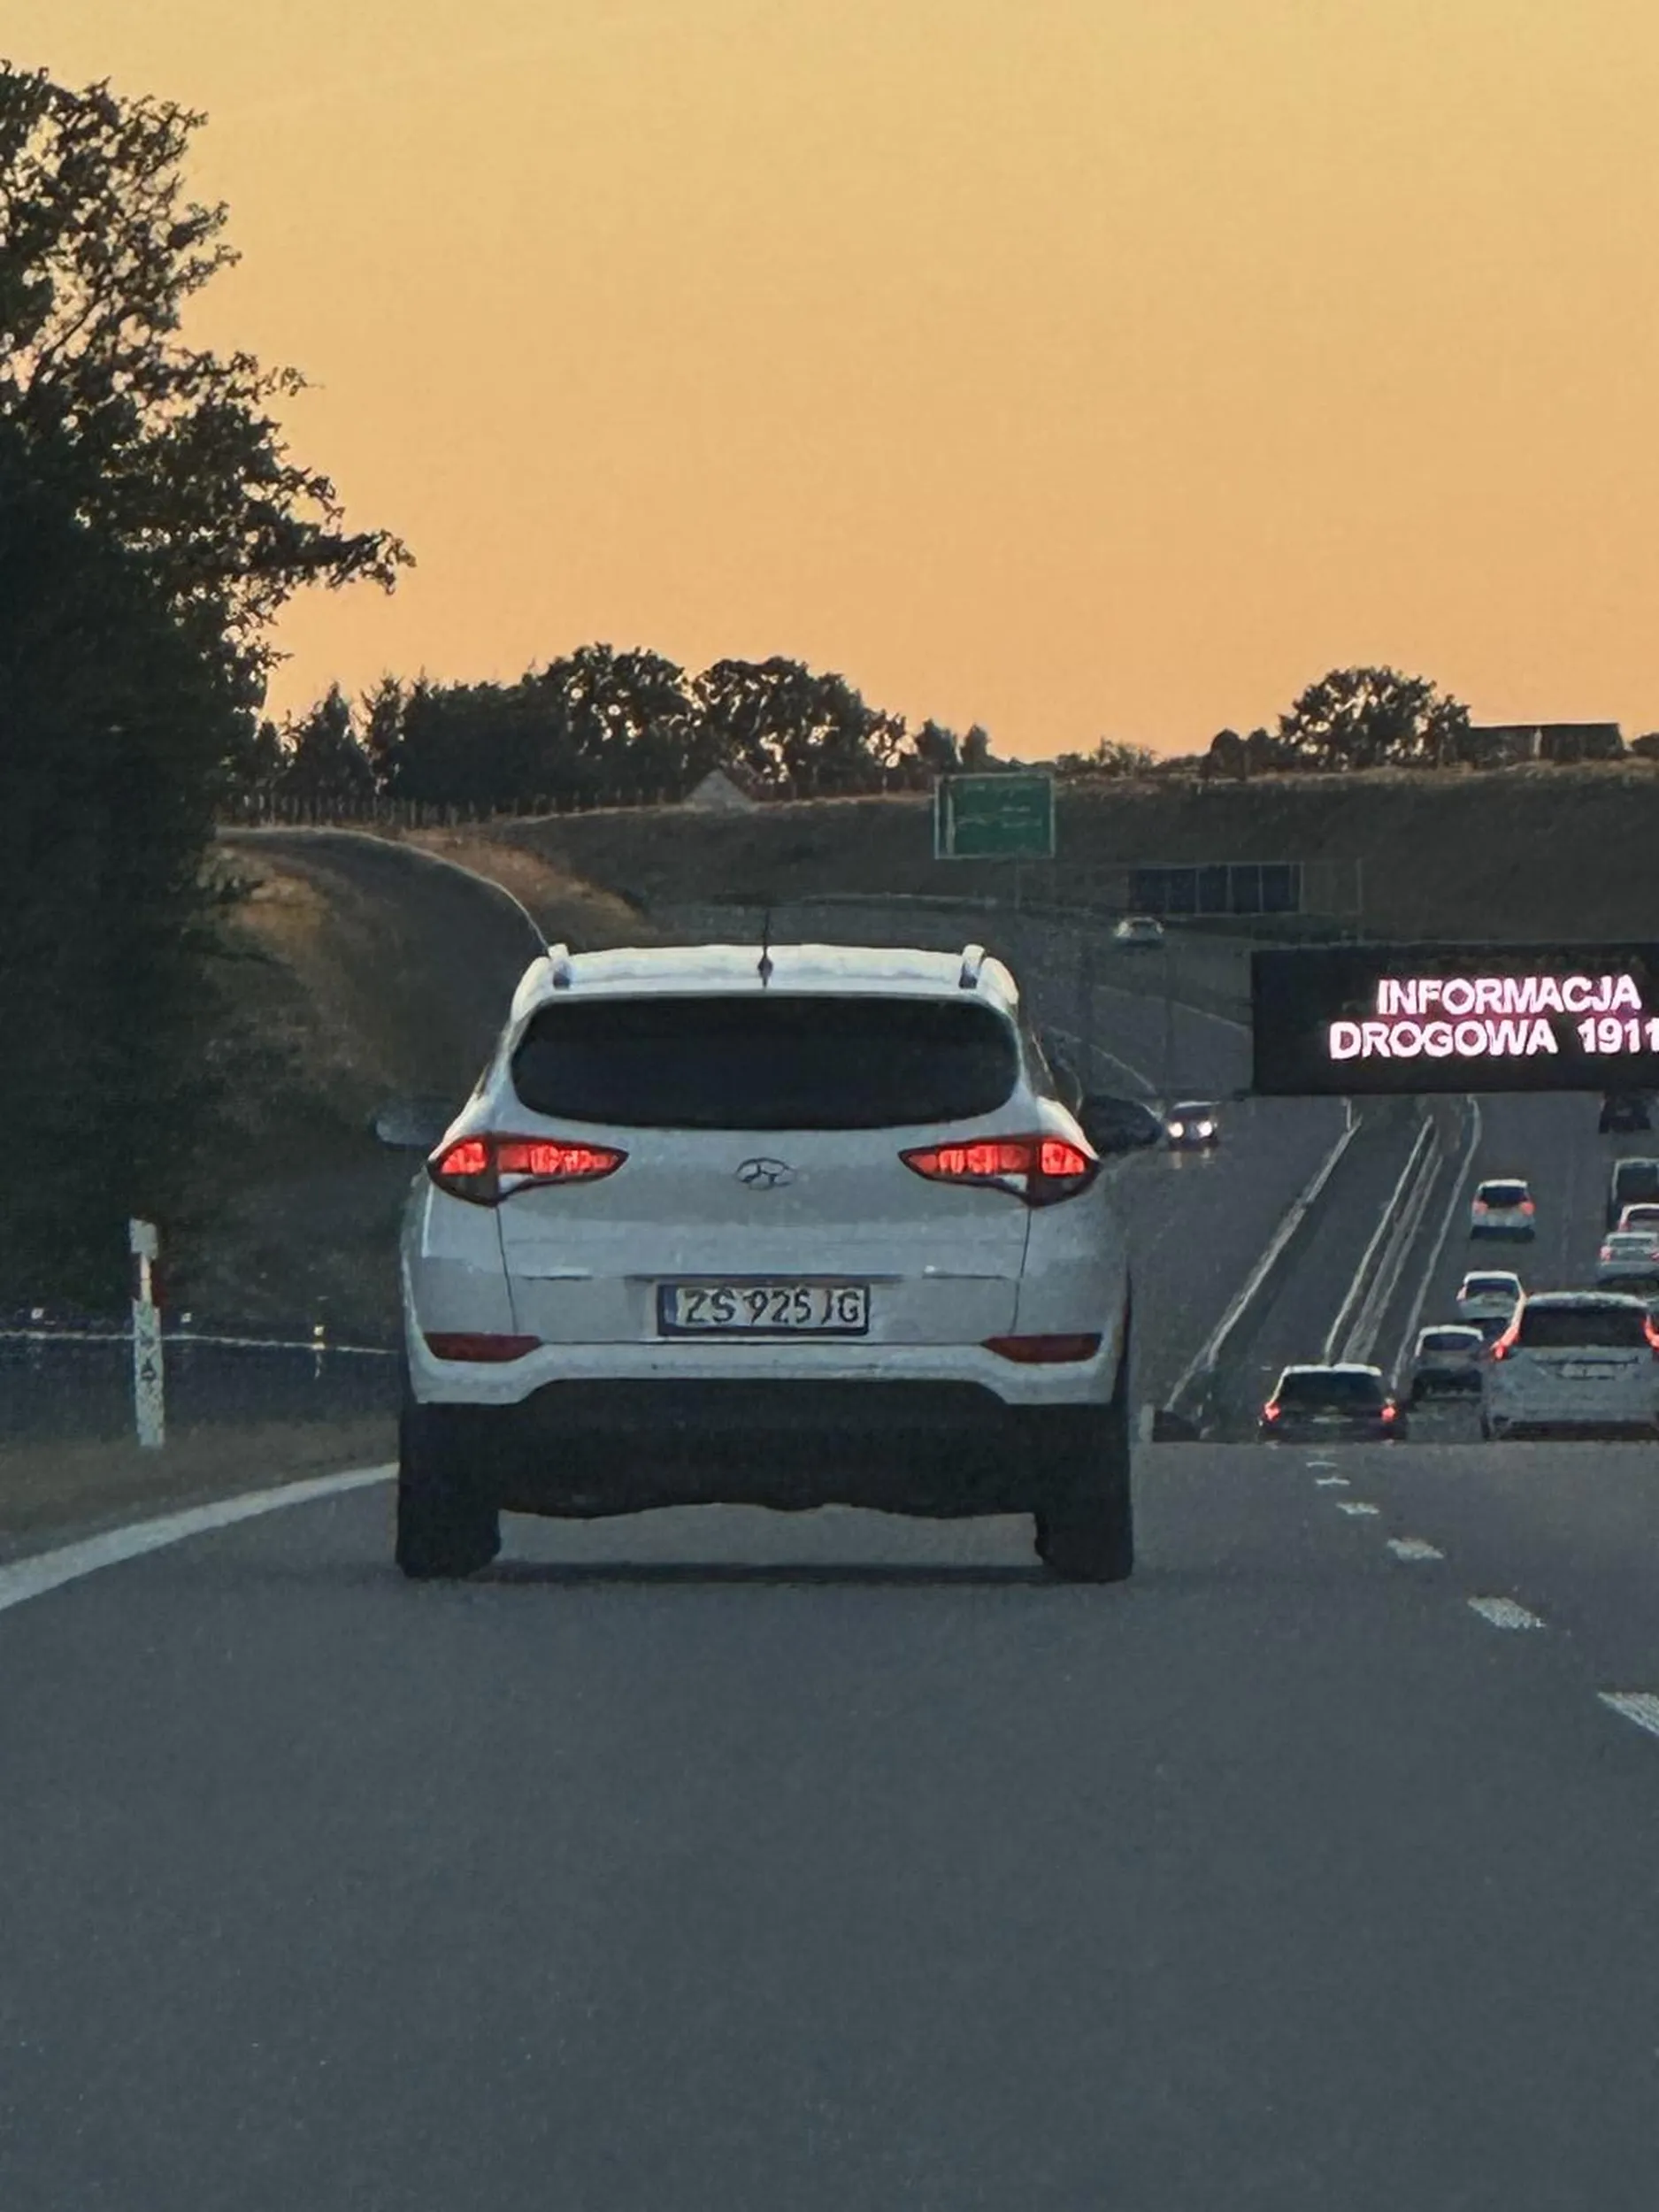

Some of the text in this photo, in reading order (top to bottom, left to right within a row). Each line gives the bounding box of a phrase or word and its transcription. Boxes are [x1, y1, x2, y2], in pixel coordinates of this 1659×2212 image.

[1377, 974, 1641, 1015] INFORMACJA
[1329, 1017, 1659, 1059] DROGOWA 1911
